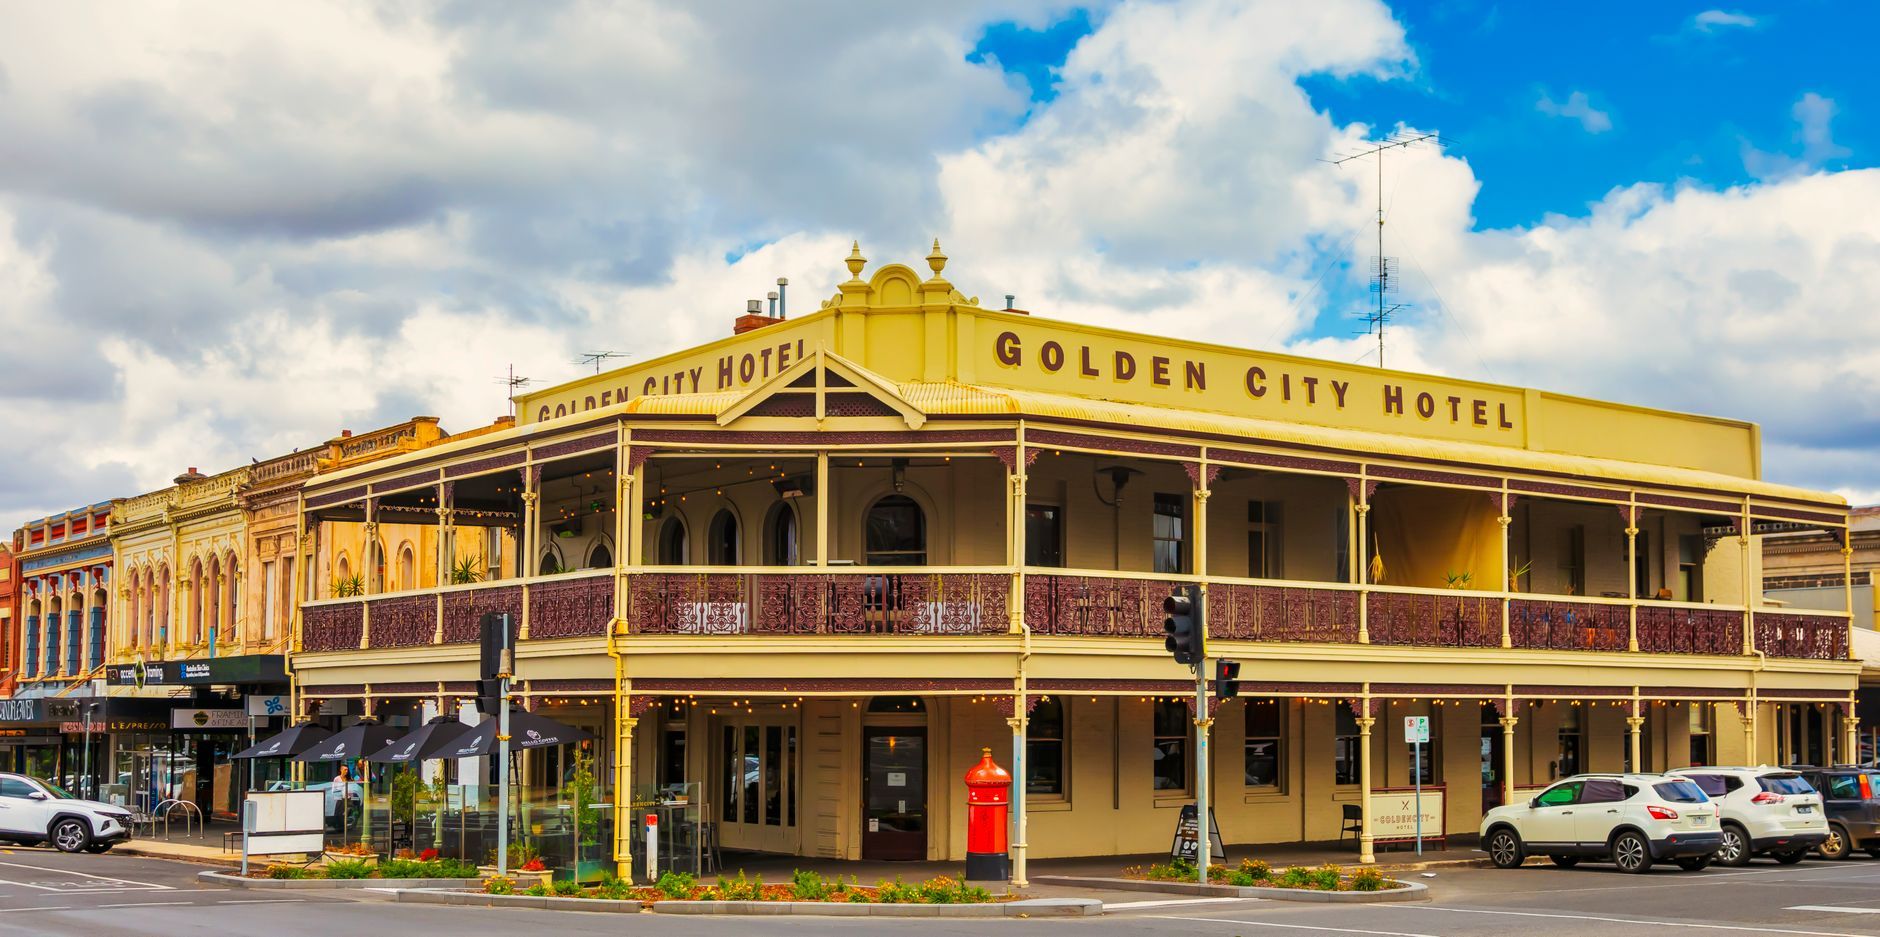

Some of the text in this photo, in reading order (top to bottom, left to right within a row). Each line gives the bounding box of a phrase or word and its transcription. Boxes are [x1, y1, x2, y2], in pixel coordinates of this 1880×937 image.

[643, 366, 703, 396] CITY
[718, 338, 804, 390] HOTEL
[996, 331, 1513, 429] GOLDEN CITY HOTEL
[1380, 813, 1430, 824] GOLDENCTY
